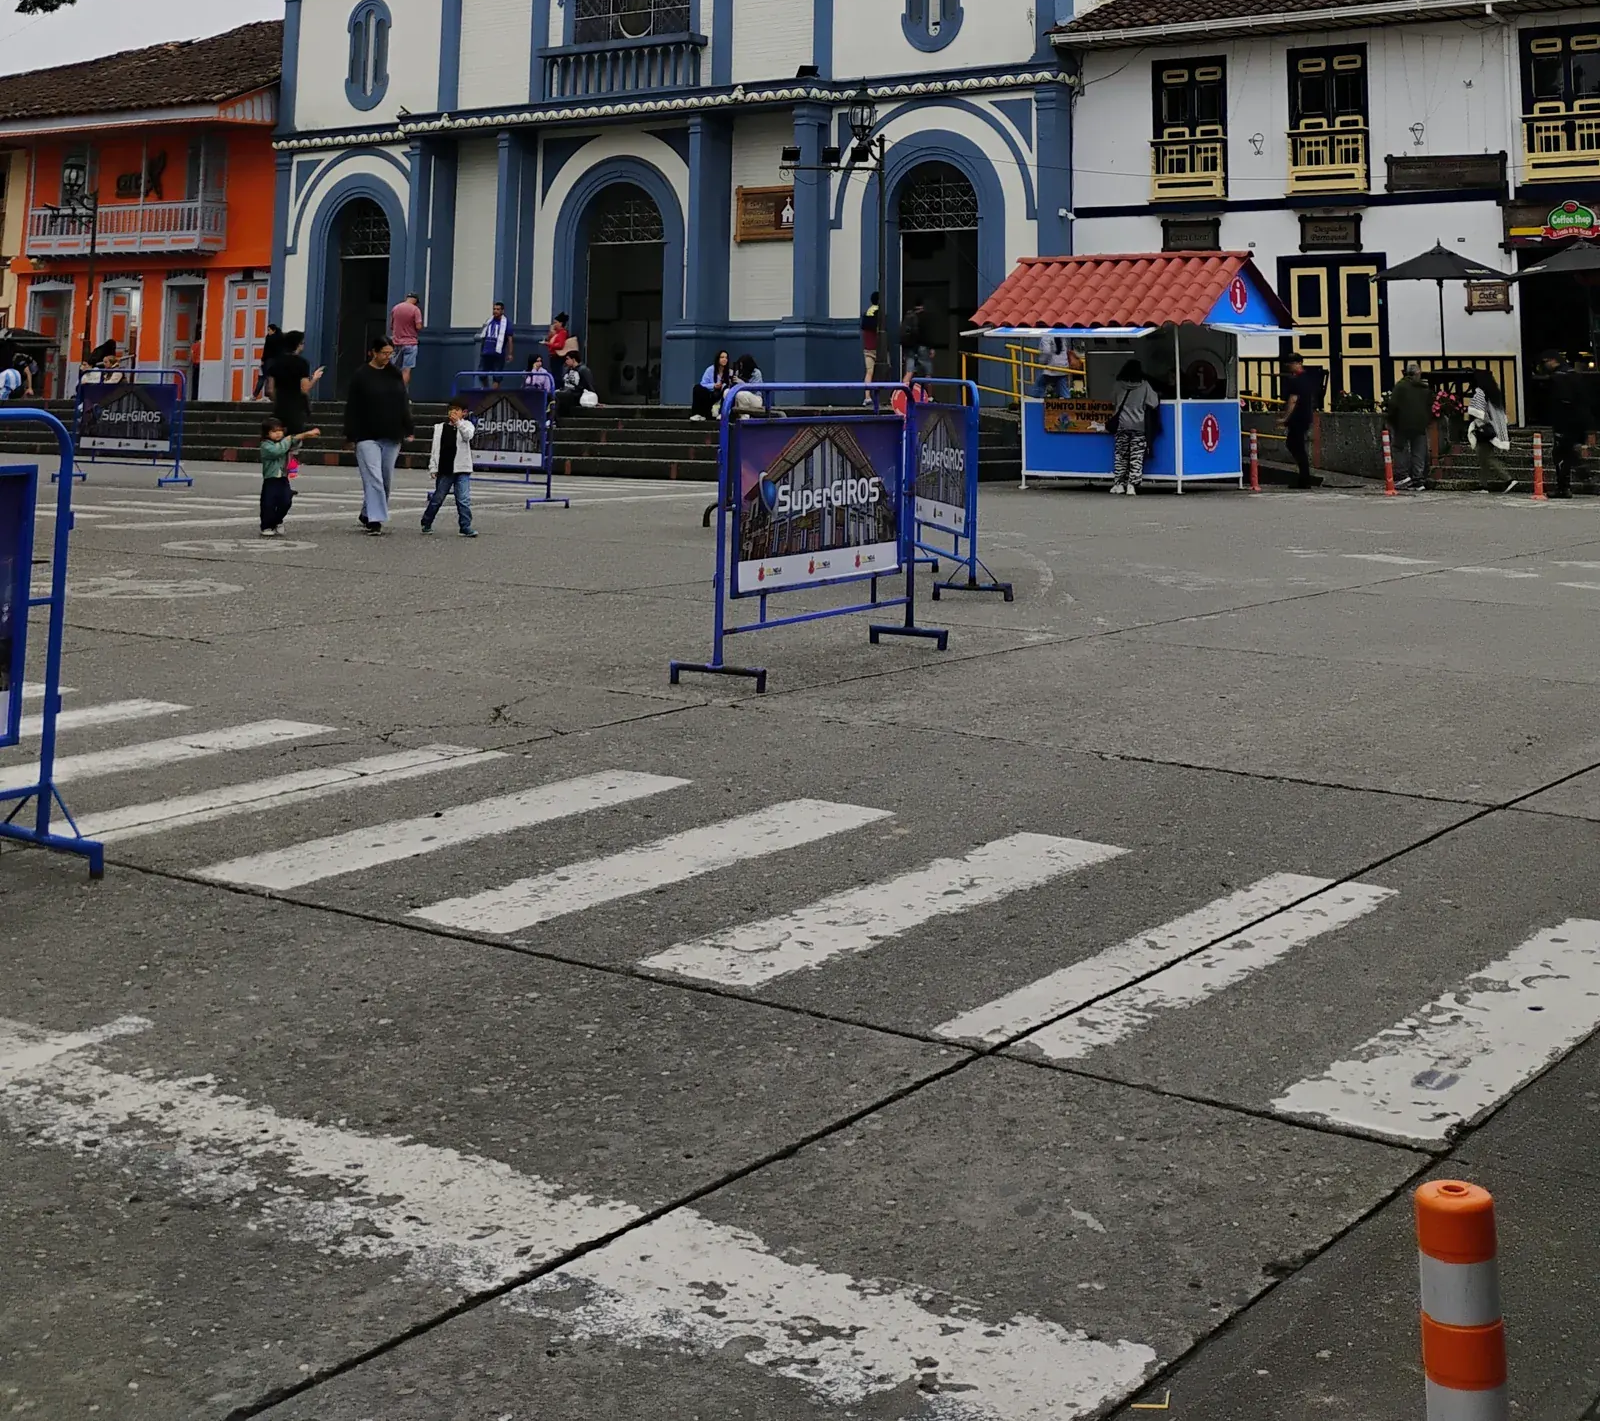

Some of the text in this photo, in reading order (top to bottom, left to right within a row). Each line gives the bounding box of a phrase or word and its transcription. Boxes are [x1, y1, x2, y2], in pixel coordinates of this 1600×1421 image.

[1551, 215, 1591, 225] Coffee Shop
[1478, 290, 1498, 299] Café
[1045, 402, 1074, 410] PUNTO
[1076, 402, 1087, 410] DE
[101, 409, 161, 424] SuperGIROS
[477, 417, 537, 434] SuperGIROS
[921, 443, 965, 472] SuperGIROS
[777, 476, 880, 516] SuperGIROS
